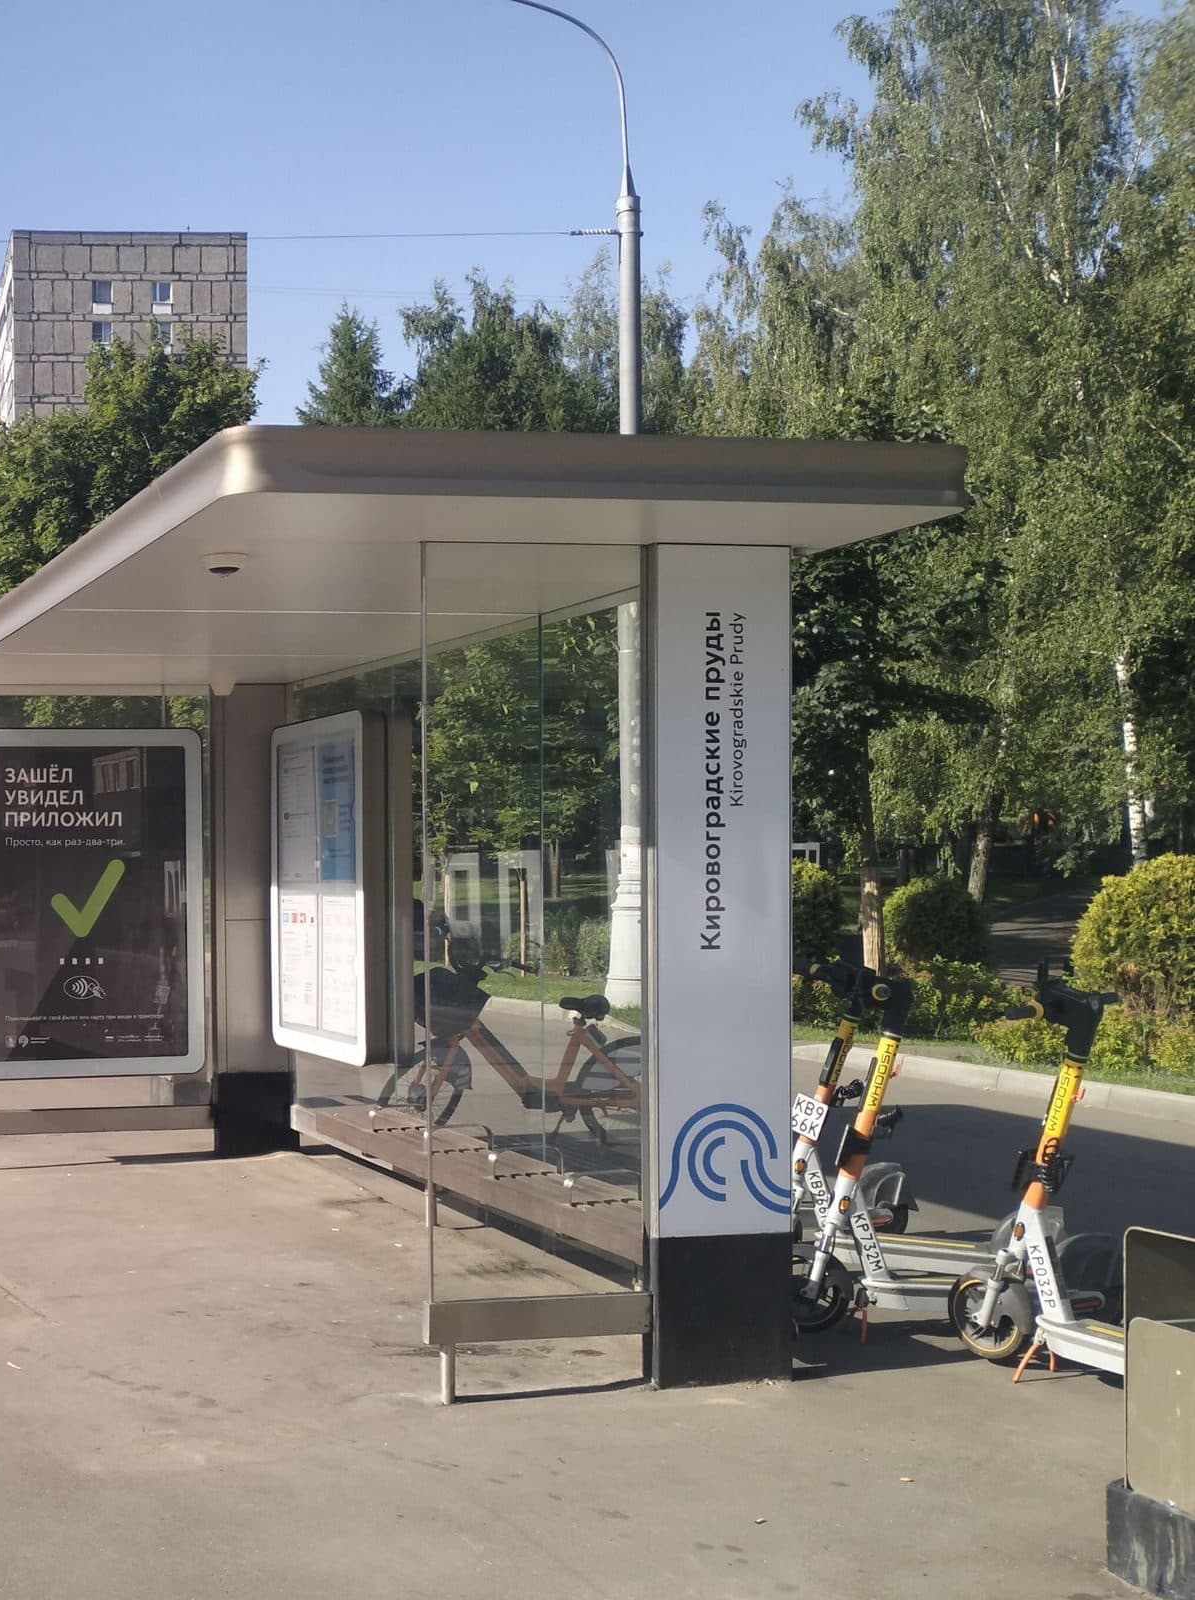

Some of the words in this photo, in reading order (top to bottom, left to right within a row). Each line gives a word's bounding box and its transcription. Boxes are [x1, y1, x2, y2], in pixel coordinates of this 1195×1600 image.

[705, 611, 725, 701] пруды
[729, 612, 747, 665] Prudy
[729, 671, 747, 807] Kirovogradskie
[4, 764, 73, 784] ЗАШЁЛ
[4, 789, 84, 808] УВИДЕЛ
[4, 811, 123, 828] ПРИЛОЖИЛ
[5, 837, 44, 848] Просто,
[700, 711, 725, 950] Кировоградские
[867, 1043, 894, 1107] WHOOSH
[1047, 1063, 1075, 1132] WHOOSH
